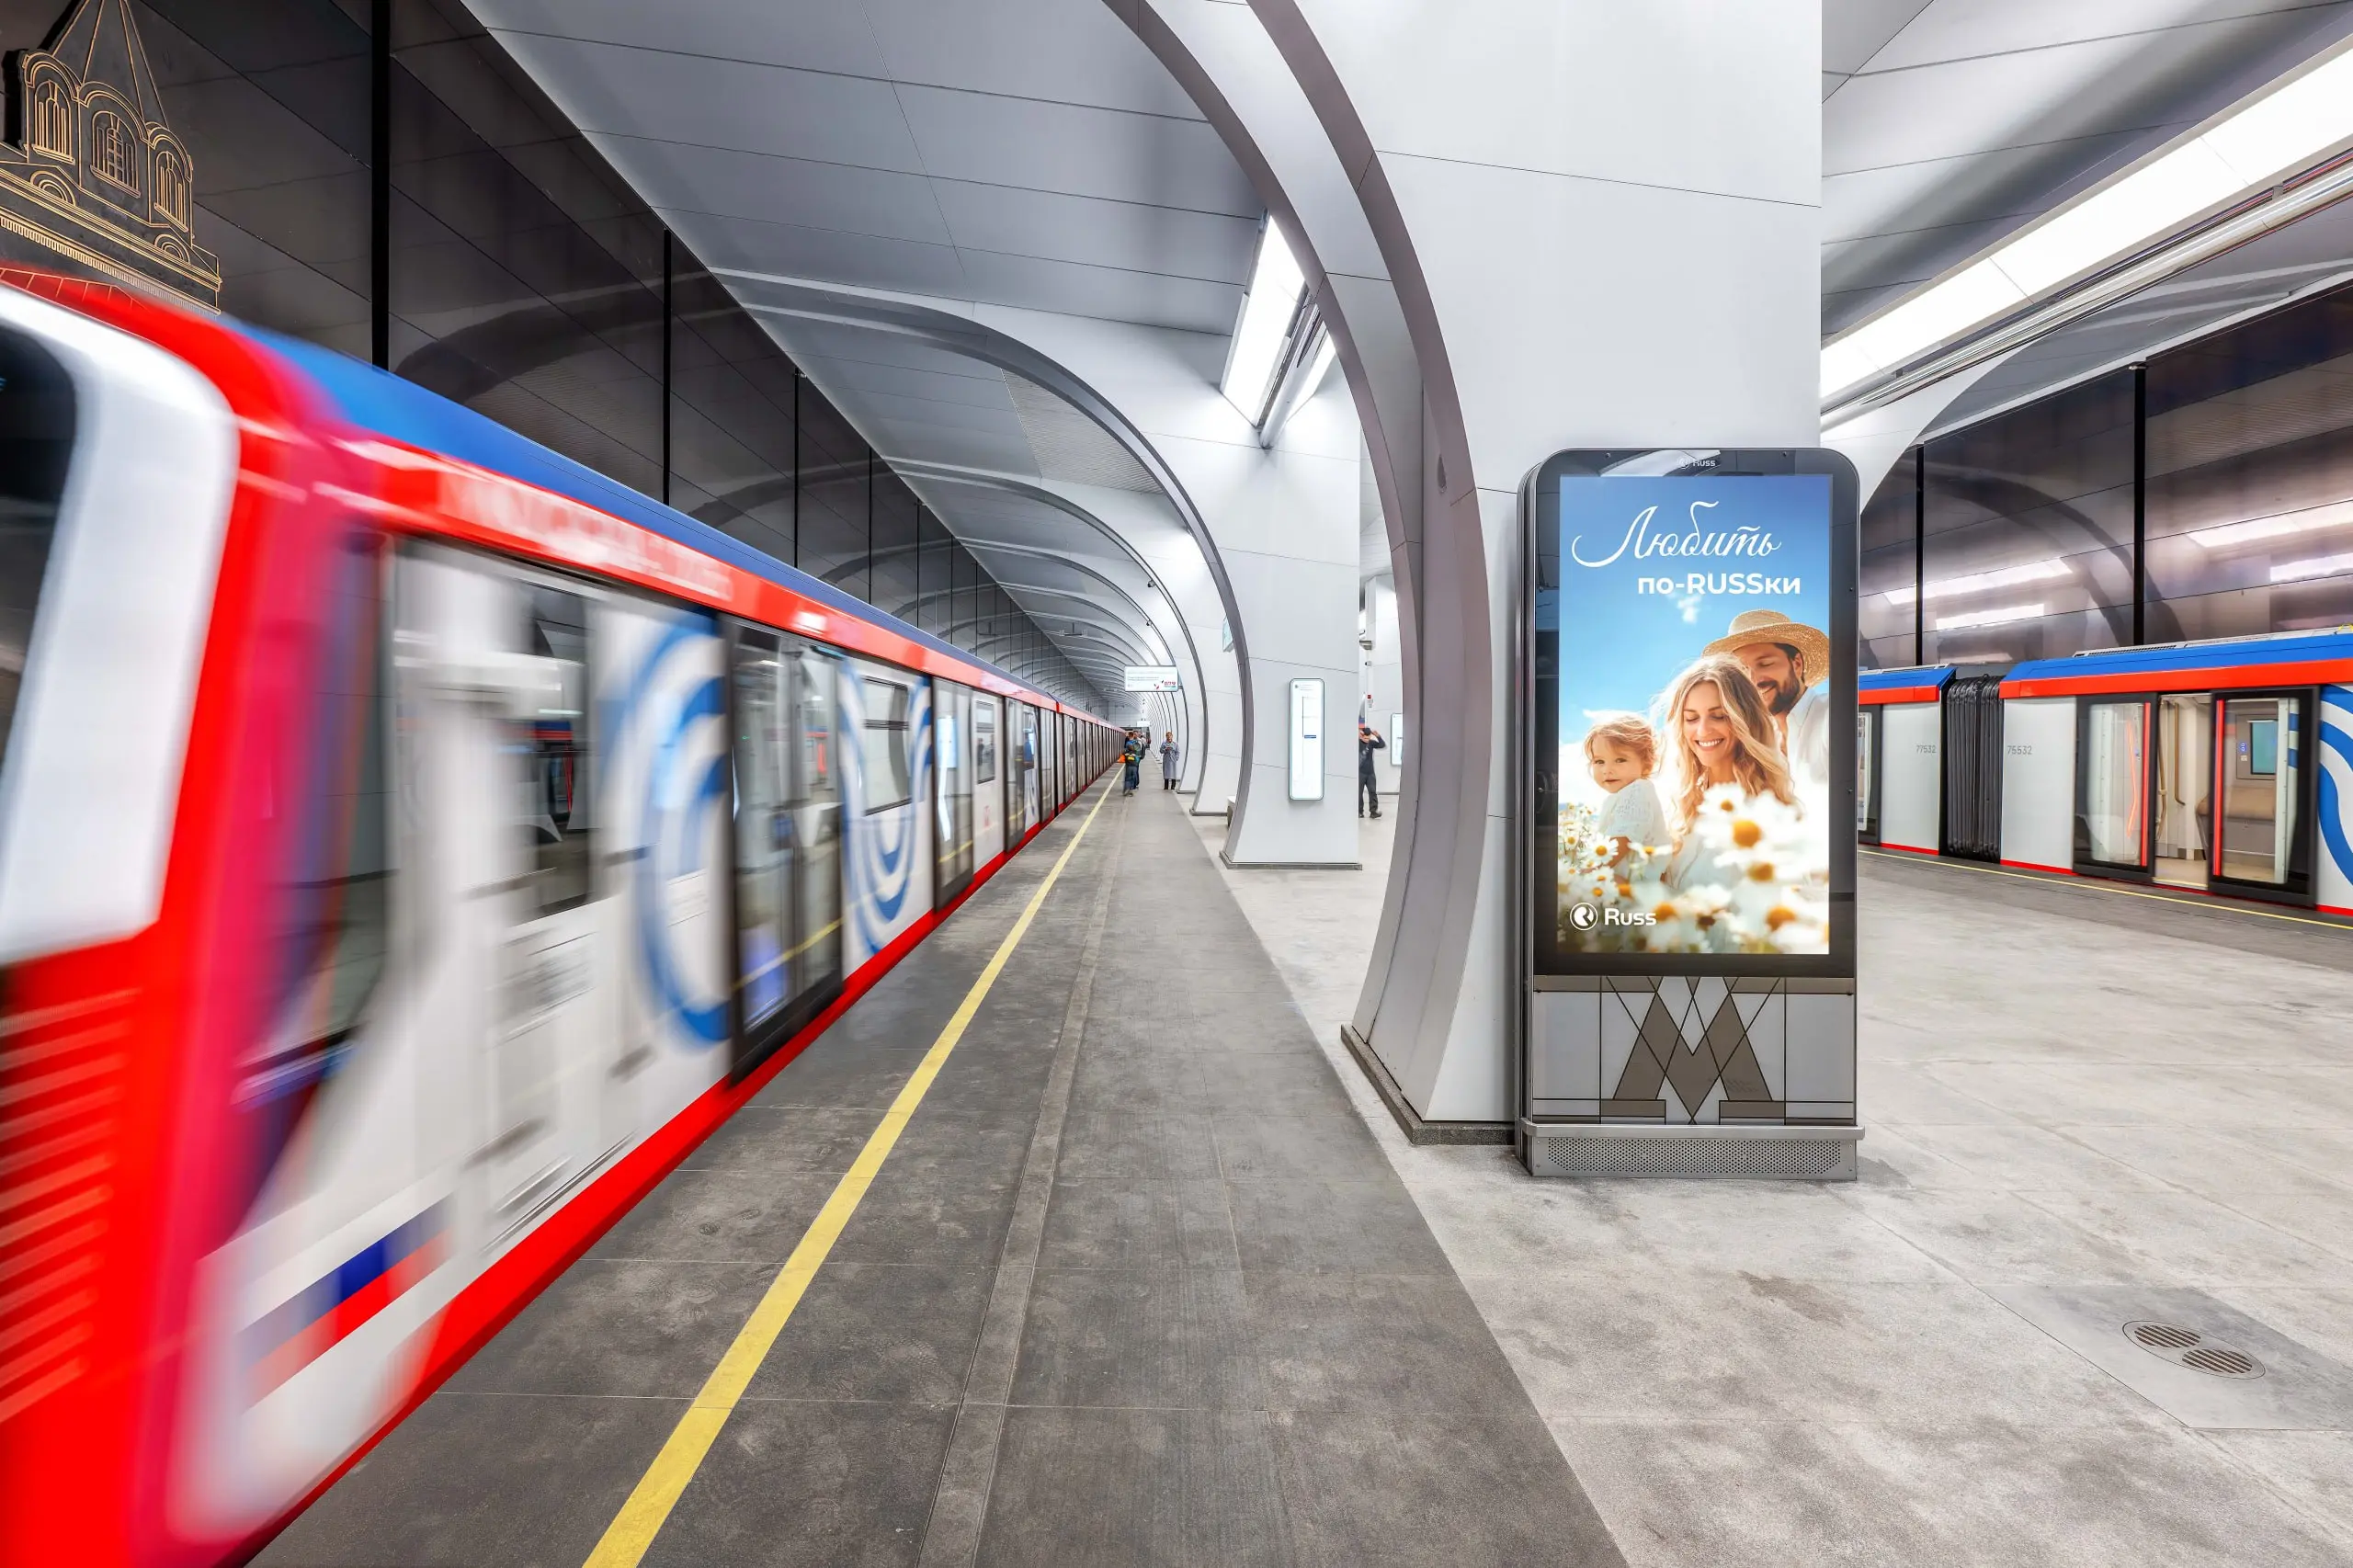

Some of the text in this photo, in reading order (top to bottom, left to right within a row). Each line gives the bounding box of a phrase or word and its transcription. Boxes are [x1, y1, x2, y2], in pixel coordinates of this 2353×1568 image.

[1571, 501, 1782, 567] Любить
[1637, 572, 1802, 595] по-RUSSки
[2006, 744, 2033, 755] 75532
[1604, 907, 1657, 926] Russ
